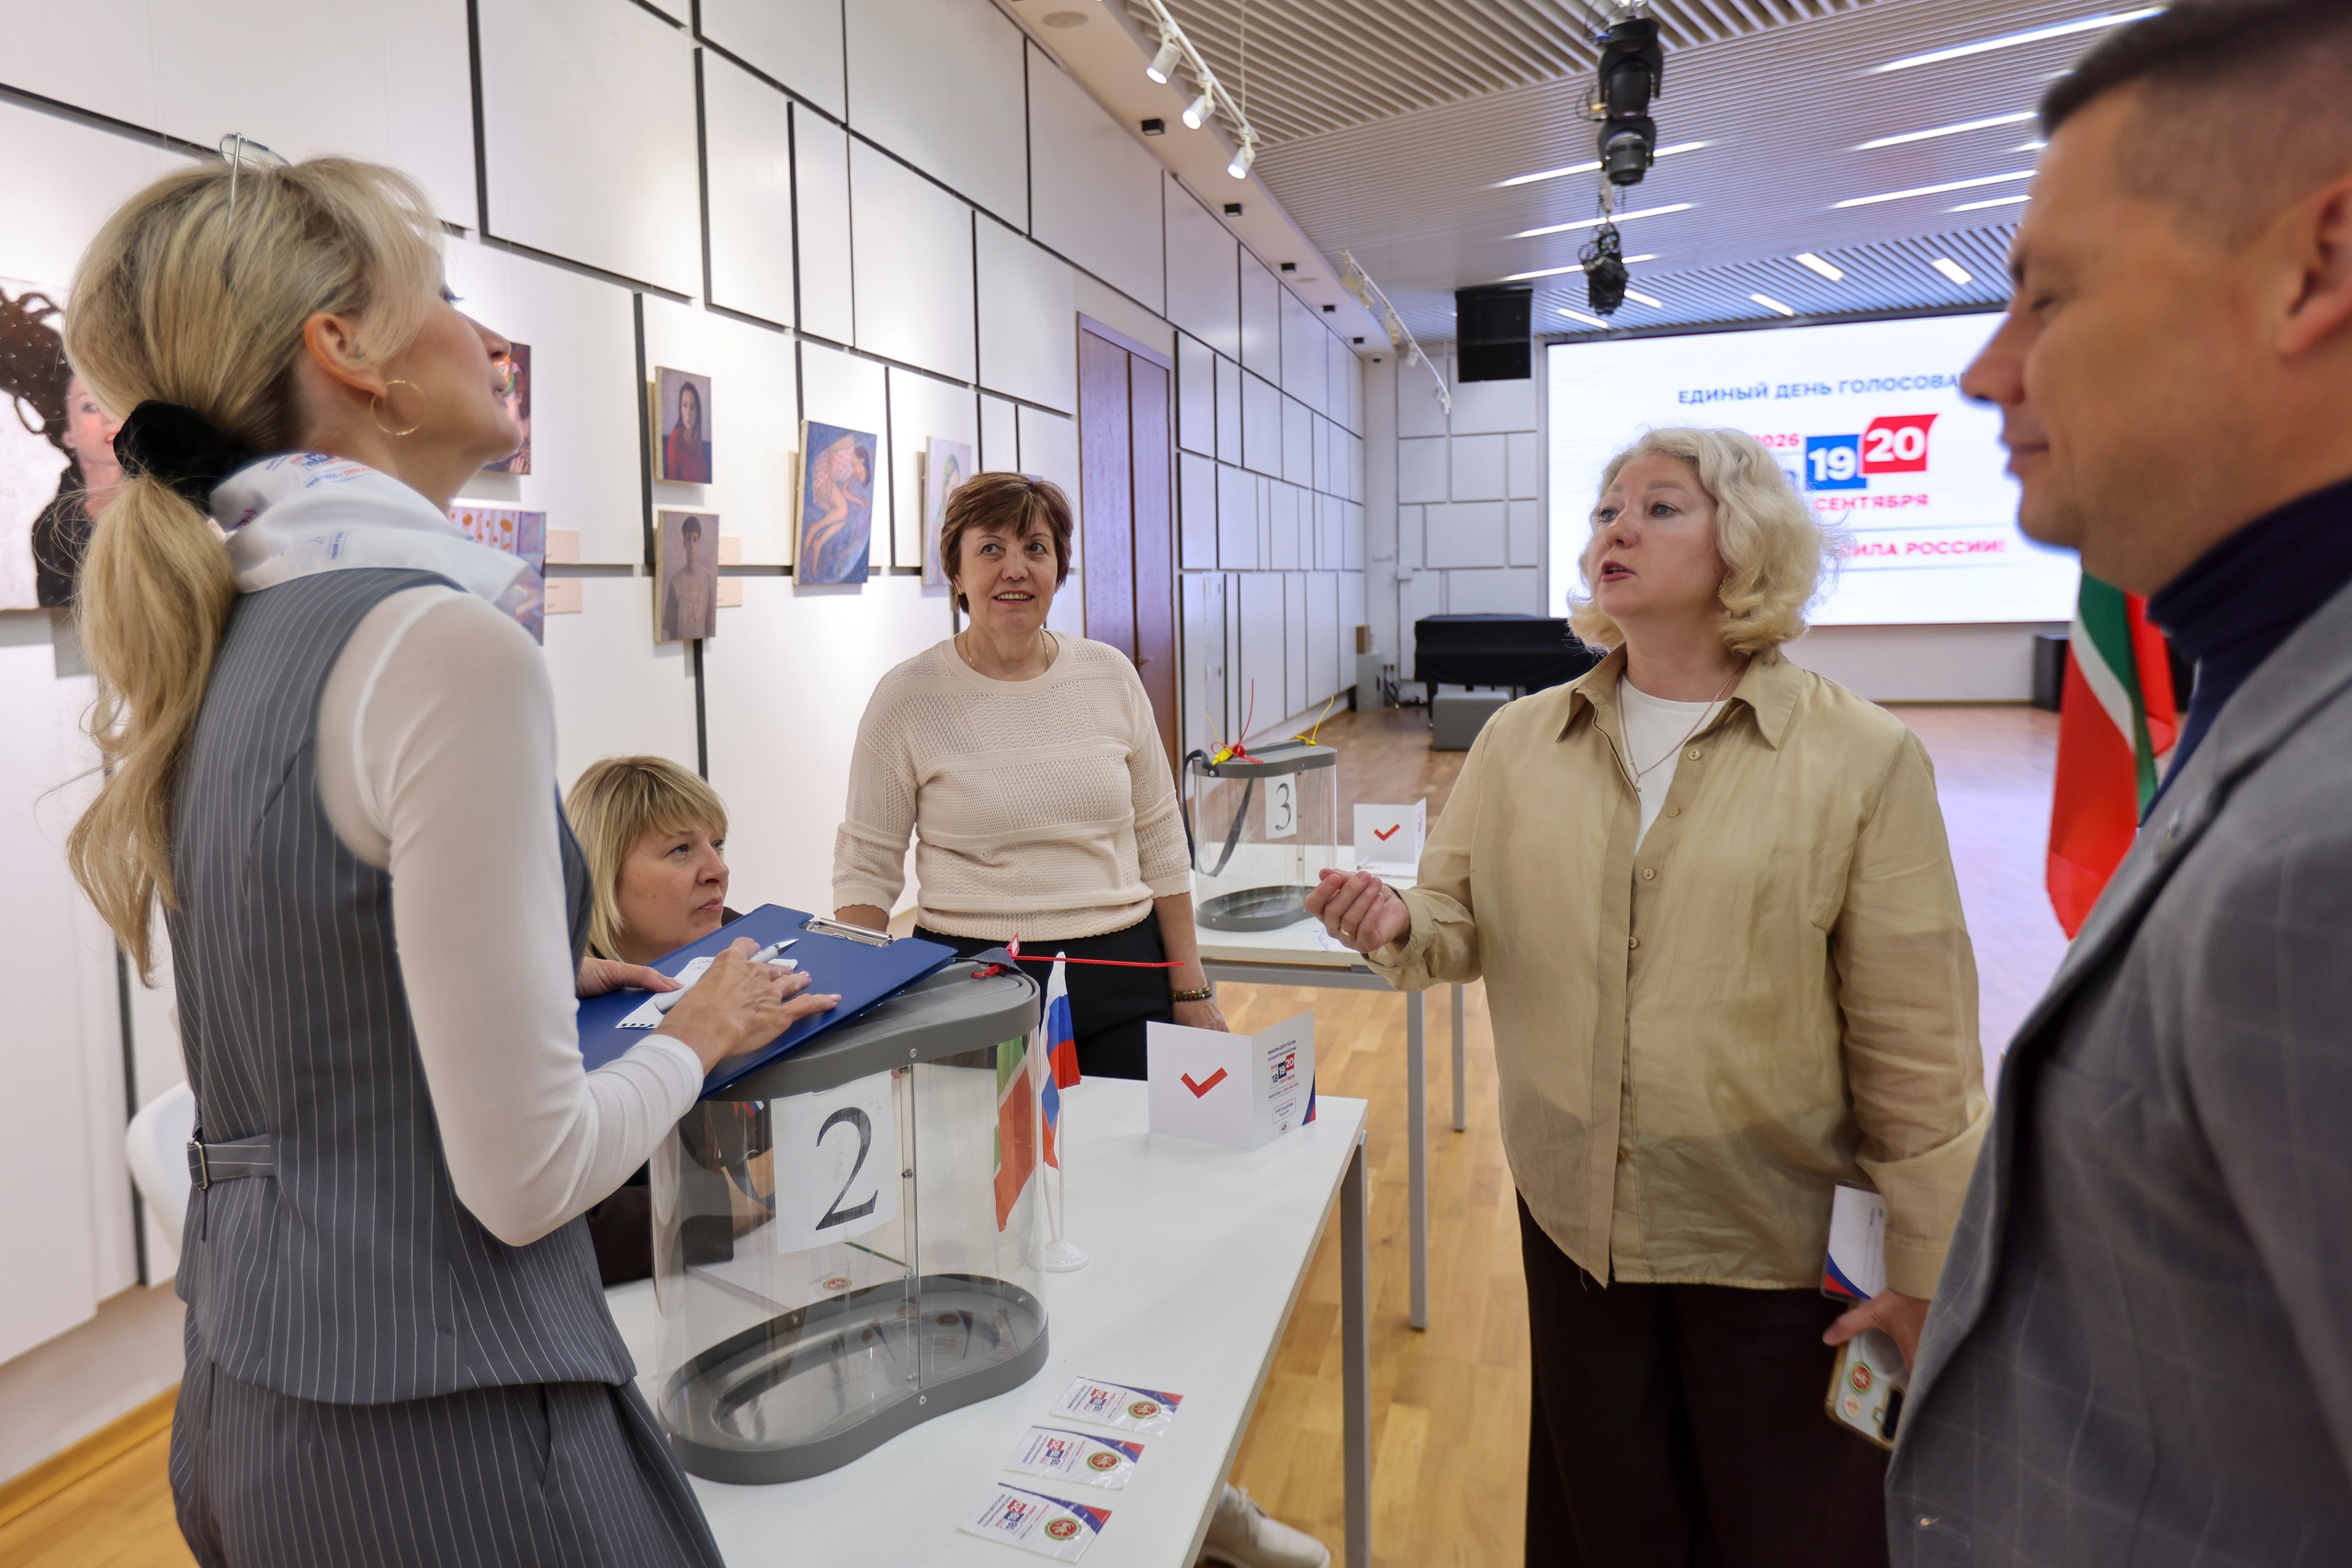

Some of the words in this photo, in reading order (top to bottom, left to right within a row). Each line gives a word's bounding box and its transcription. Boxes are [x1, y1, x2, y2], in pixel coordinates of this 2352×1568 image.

[1679, 382, 1769, 405] ЕДИНЫЙ
[1775, 382, 1832, 400] ДЕНЬ
[1839, 374, 1963, 393] ГОЛОСОВА
[1808, 446, 1857, 481] 19
[1865, 426, 1927, 462] 20
[1815, 493, 1929, 511] СЕНТЯБРЯ
[1906, 539, 2006, 555] РОССИИ!
[1275, 783, 1292, 830] 3
[1278, 1066, 1285, 1076] 19
[1286, 1057, 1294, 1068] 20
[816, 1107, 878, 1231] 2
